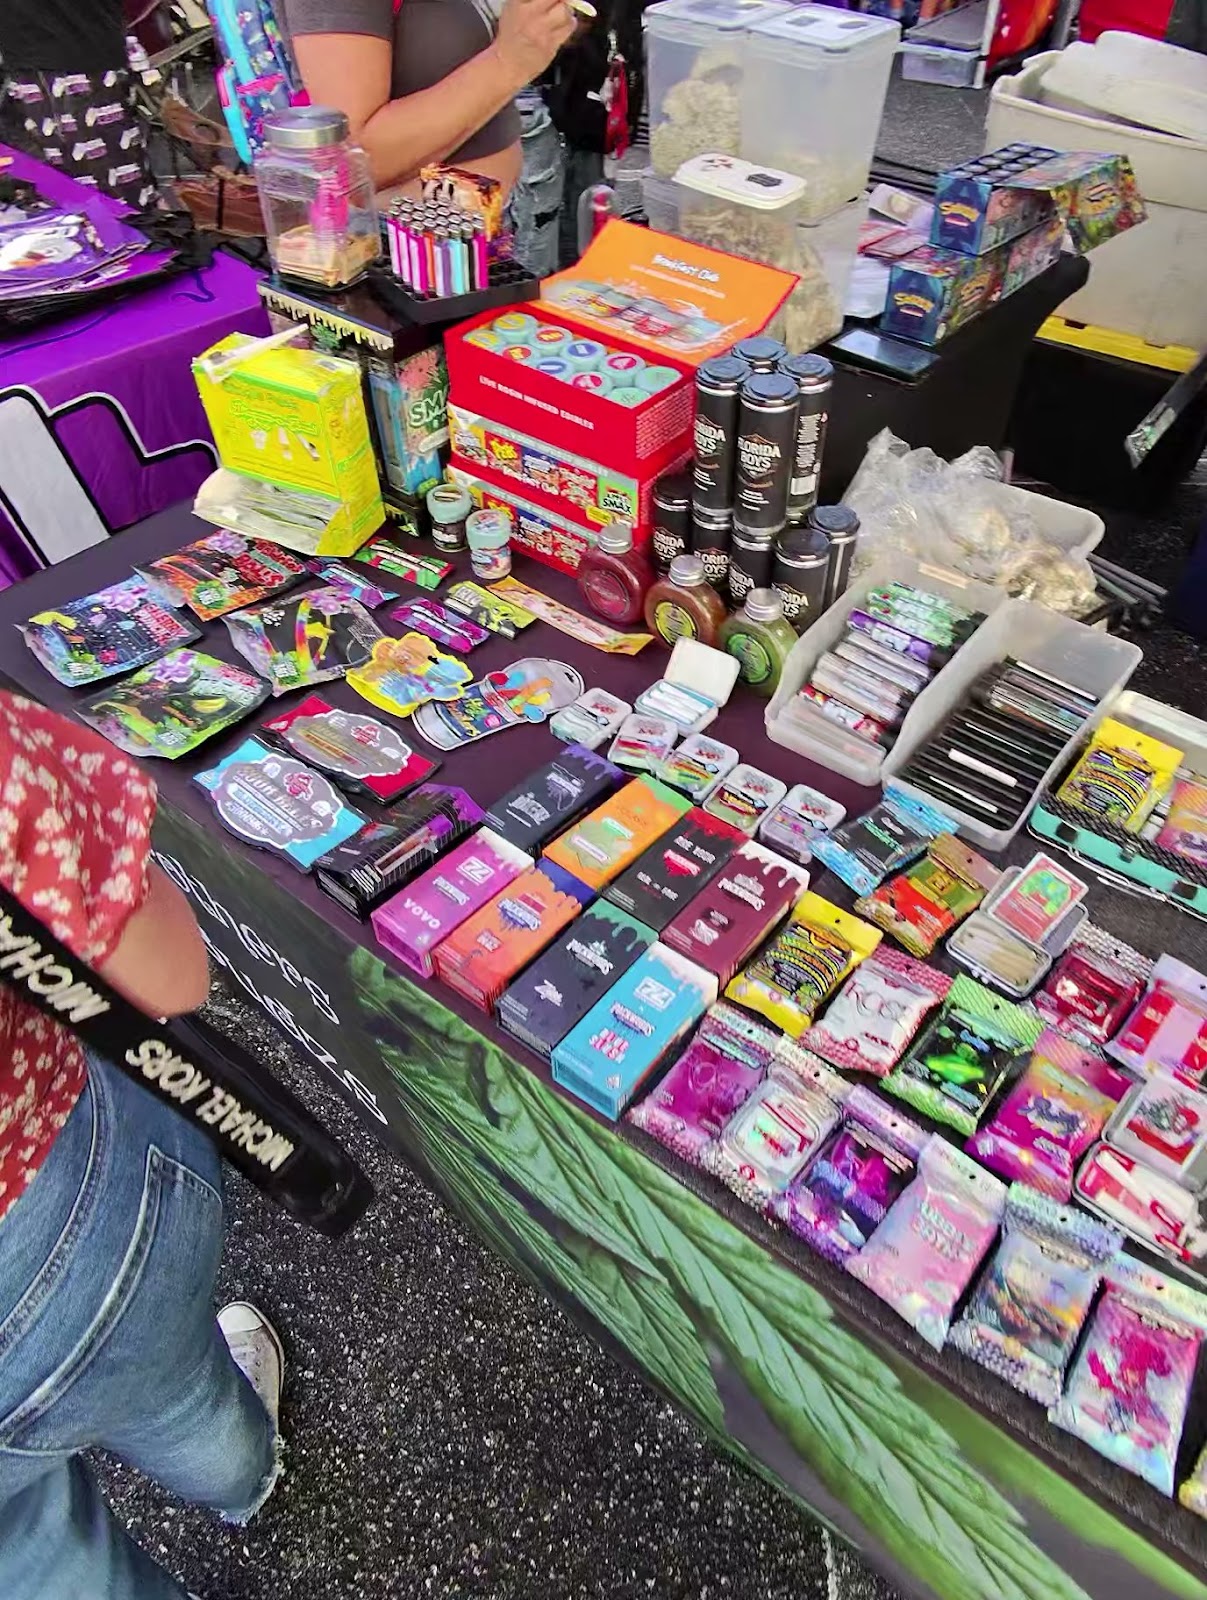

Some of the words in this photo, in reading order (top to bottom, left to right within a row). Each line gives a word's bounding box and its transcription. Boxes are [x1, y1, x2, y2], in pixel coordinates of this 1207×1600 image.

[737, 436, 782, 458] FLORIDA
[740, 450, 772, 468] BOYS
[703, 563, 729, 575] OYS
[782, 601, 801, 615] YS
[125, 1039, 211, 1104] KORS
[195, 1086, 295, 1172] MICHAEL
